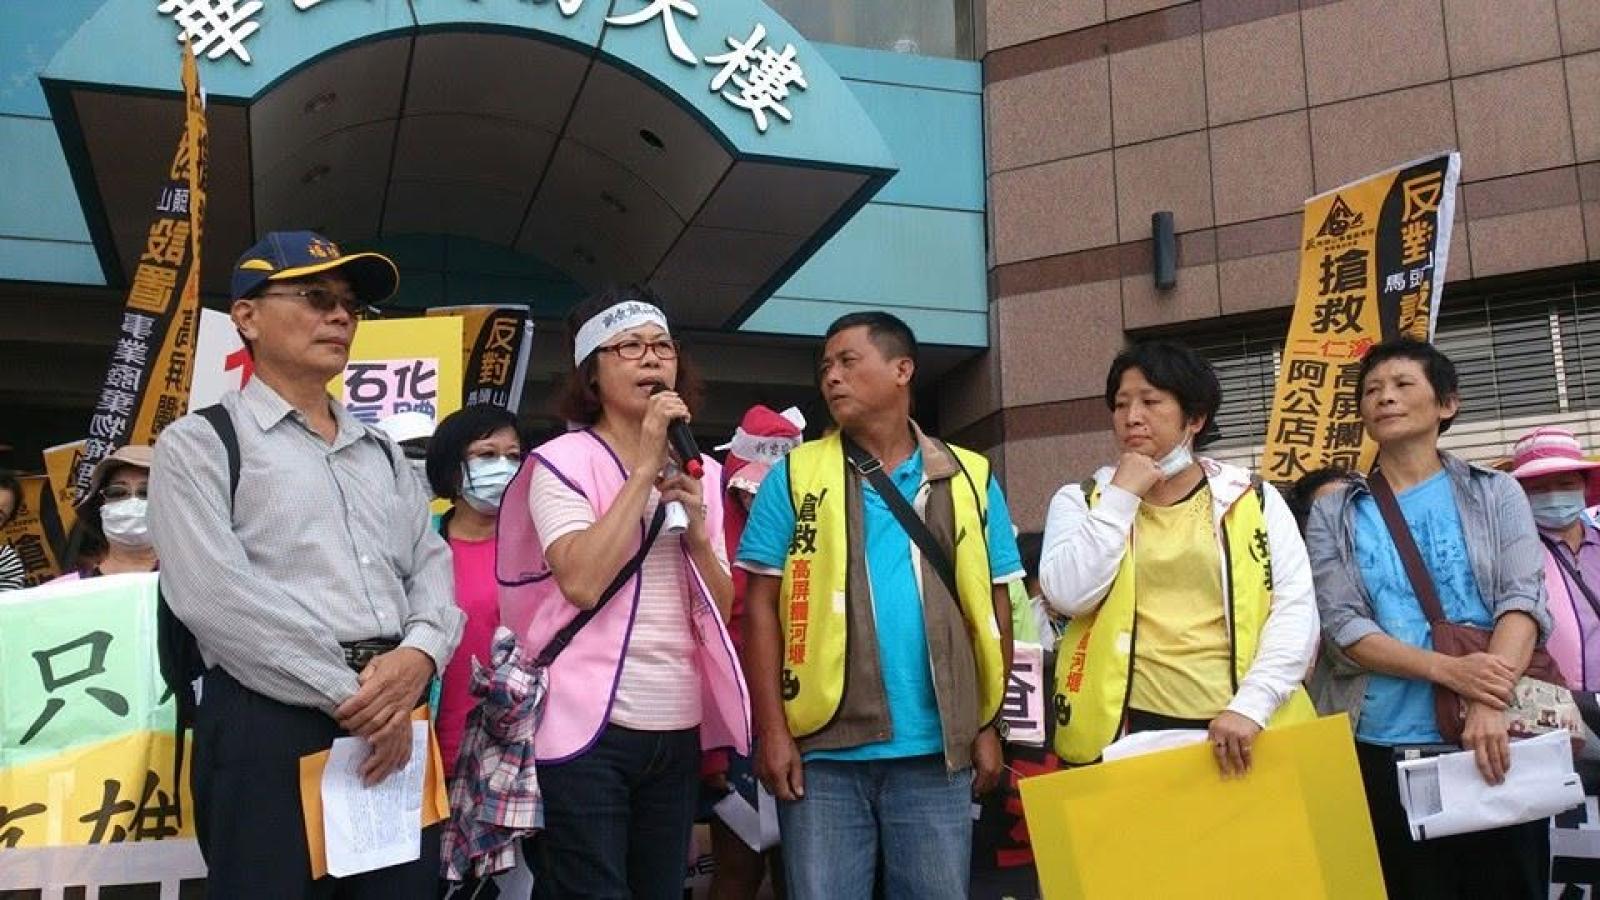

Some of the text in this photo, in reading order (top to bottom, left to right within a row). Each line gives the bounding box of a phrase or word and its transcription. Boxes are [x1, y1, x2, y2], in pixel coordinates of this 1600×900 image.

[1401, 170, 1444, 266] 反對
[1310, 249, 1370, 334] 搶救
[345, 359, 437, 403] 石化
[479, 317, 518, 386] 反對
[1269, 359, 1329, 477] 阿公店水
